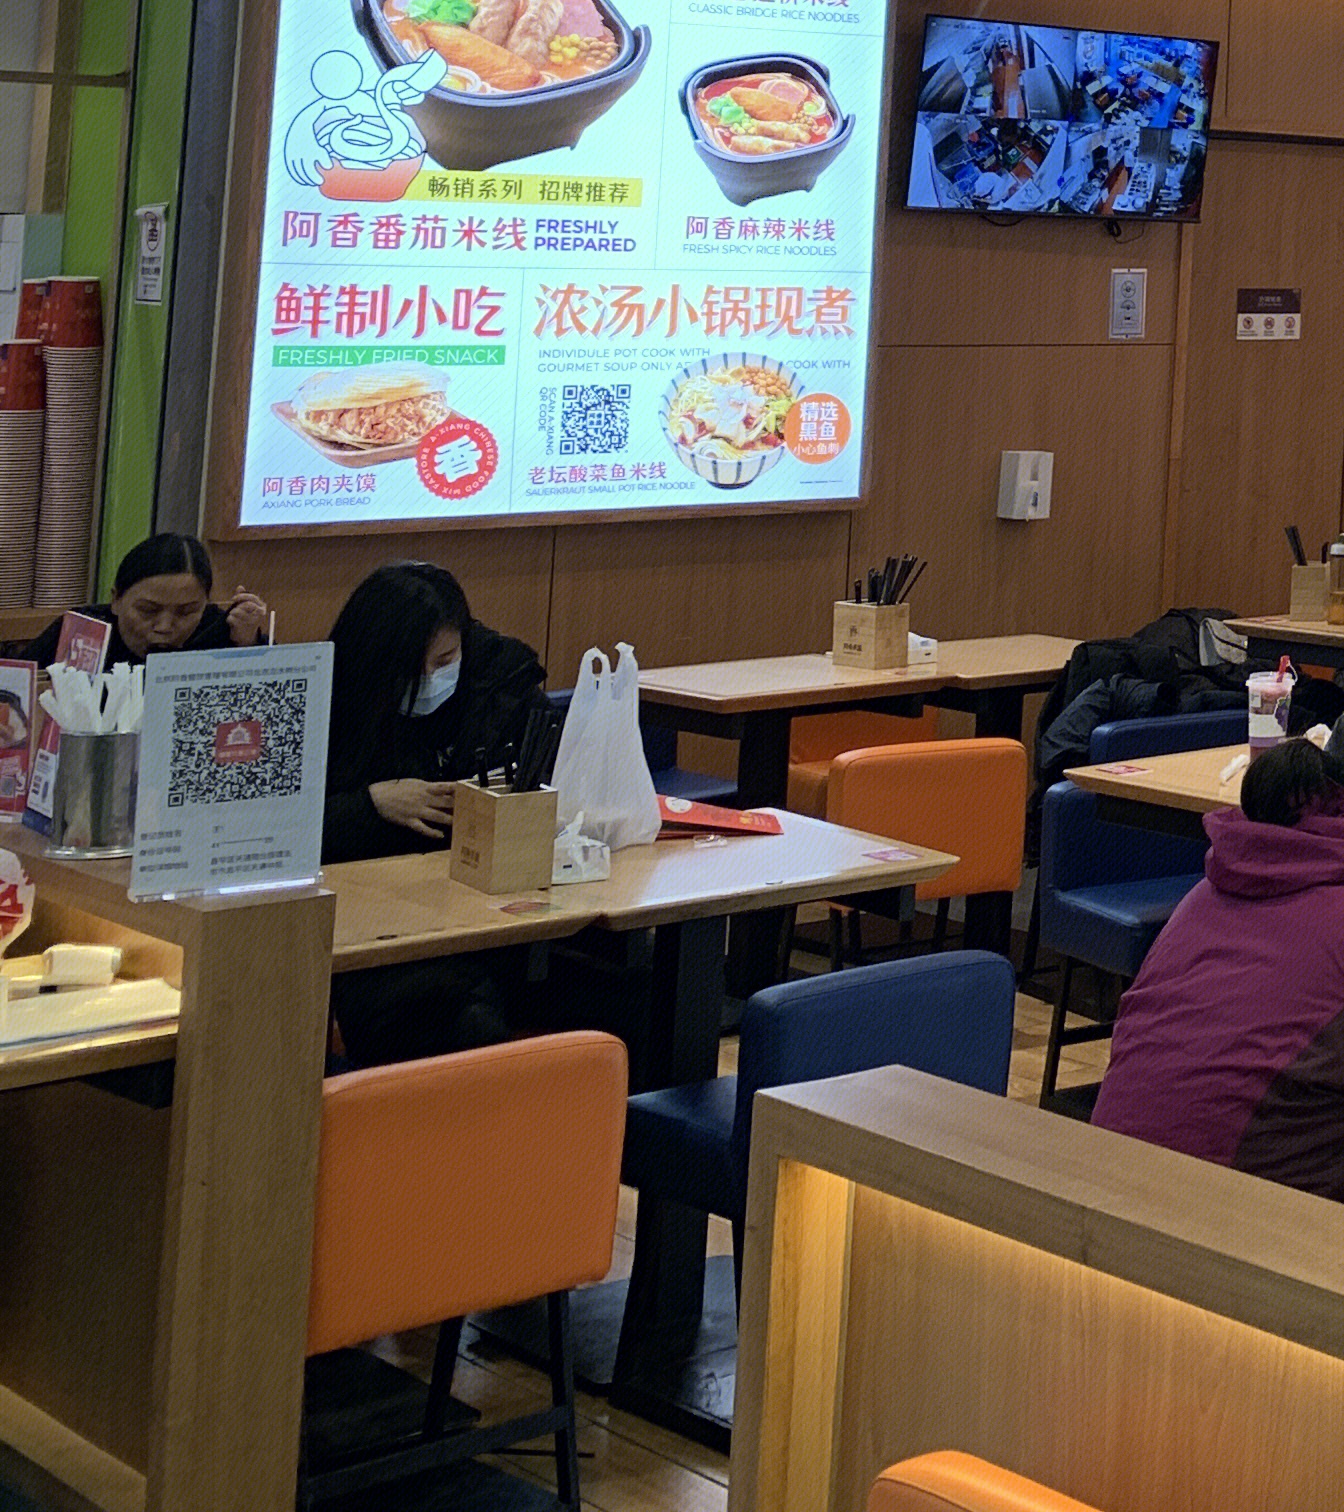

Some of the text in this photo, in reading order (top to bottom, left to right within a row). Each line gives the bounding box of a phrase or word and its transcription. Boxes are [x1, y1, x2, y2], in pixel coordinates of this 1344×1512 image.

[688, 2, 860, 24] CLASSIC BRIDGE RICE NOODLES
[427, 176, 630, 204] 畅销系列 招牌推荐
[281, 210, 529, 252] 阿香番茄米线
[534, 219, 619, 235] FRESHLY
[685, 215, 836, 243] 阿香麻辣米线
[533, 236, 637, 252] PREPARED
[682, 243, 837, 256] FRESH SPICY RICE NOODLES
[271, 281, 507, 339] 鲜制小吃
[533, 283, 856, 338] 浓汤小锅现煮
[278, 349, 367, 365] FRESHLY
[434, 349, 499, 364] SNACK
[538, 347, 711, 359] INDIVIDULE POT COOK WITH
[537, 362, 600, 373] GOURMET
[603, 362, 637, 372] SOUP
[640, 361, 672, 372] ONLY
[821, 360, 851, 370] WITH
[538, 404, 547, 432] CODE
[800, 400, 839, 421] 精选
[799, 421, 837, 441] 黑鱼
[528, 462, 667, 485] 老坛酸菜鱼米线
[262, 472, 377, 497] 阿香肉夹馍
[525, 486, 587, 496] SAUERKRAUT
[618, 484, 636, 493] POT
[637, 482, 658, 491] RICE
[659, 481, 696, 490] NOODLE
[262, 496, 370, 509] AXIANG PORK BREAD
